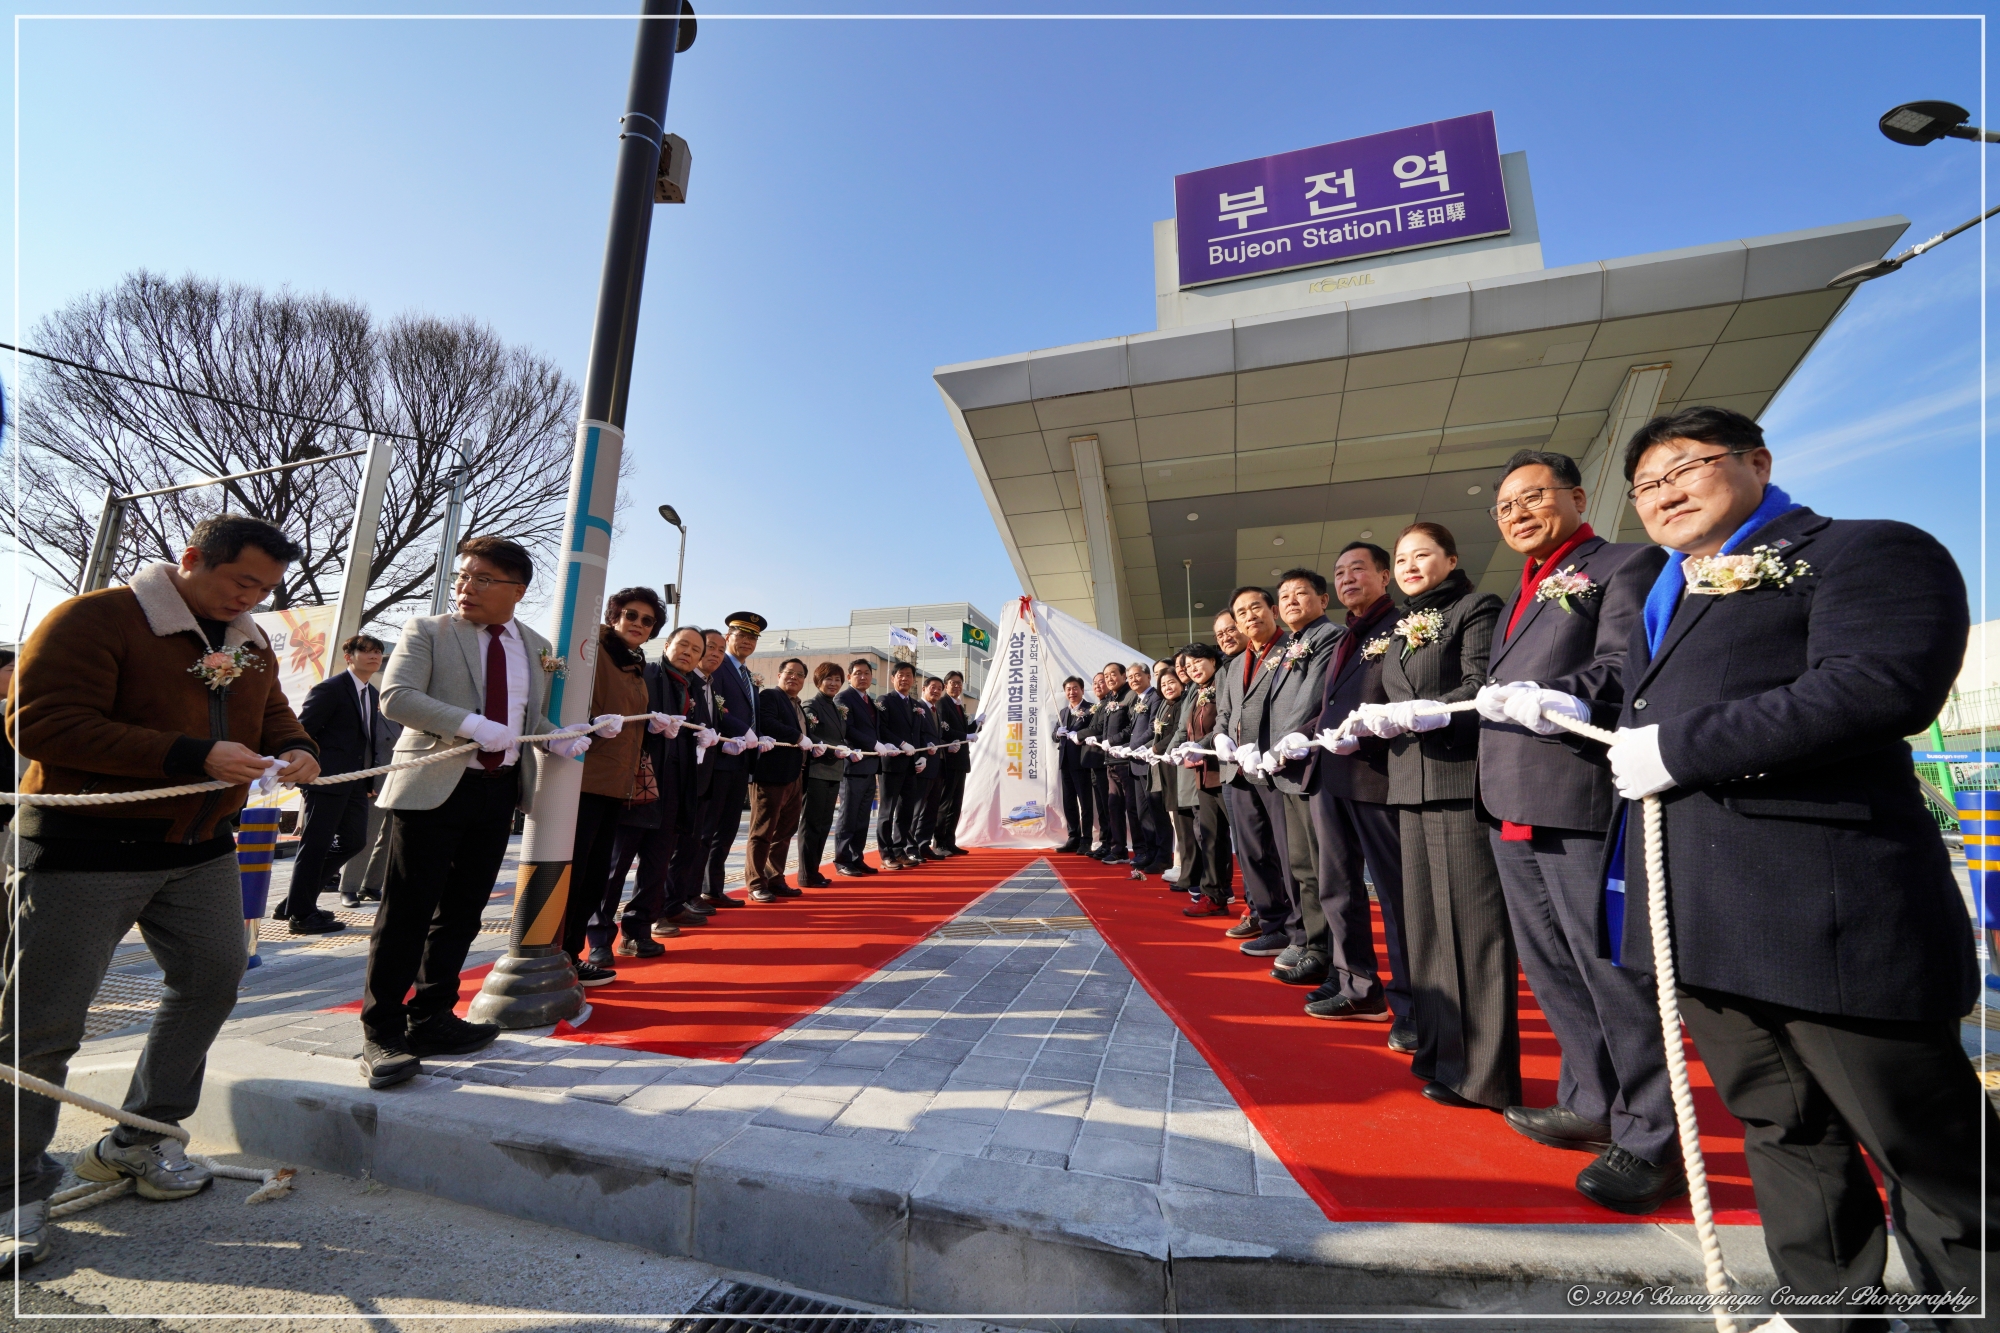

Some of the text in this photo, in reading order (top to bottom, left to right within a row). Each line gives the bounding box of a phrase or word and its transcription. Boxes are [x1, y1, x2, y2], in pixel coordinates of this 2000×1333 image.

[1218, 150, 1450, 229] 부전역
[1406, 201, 1466, 230] 釜田驛
[1208, 215, 1391, 266] Bujeon Station
[1309, 273, 1375, 294] KORAIL
[1029, 665, 1038, 703] 고속철도
[1028, 706, 1038, 737] 맞이길
[1028, 739, 1038, 779] 조성사업
